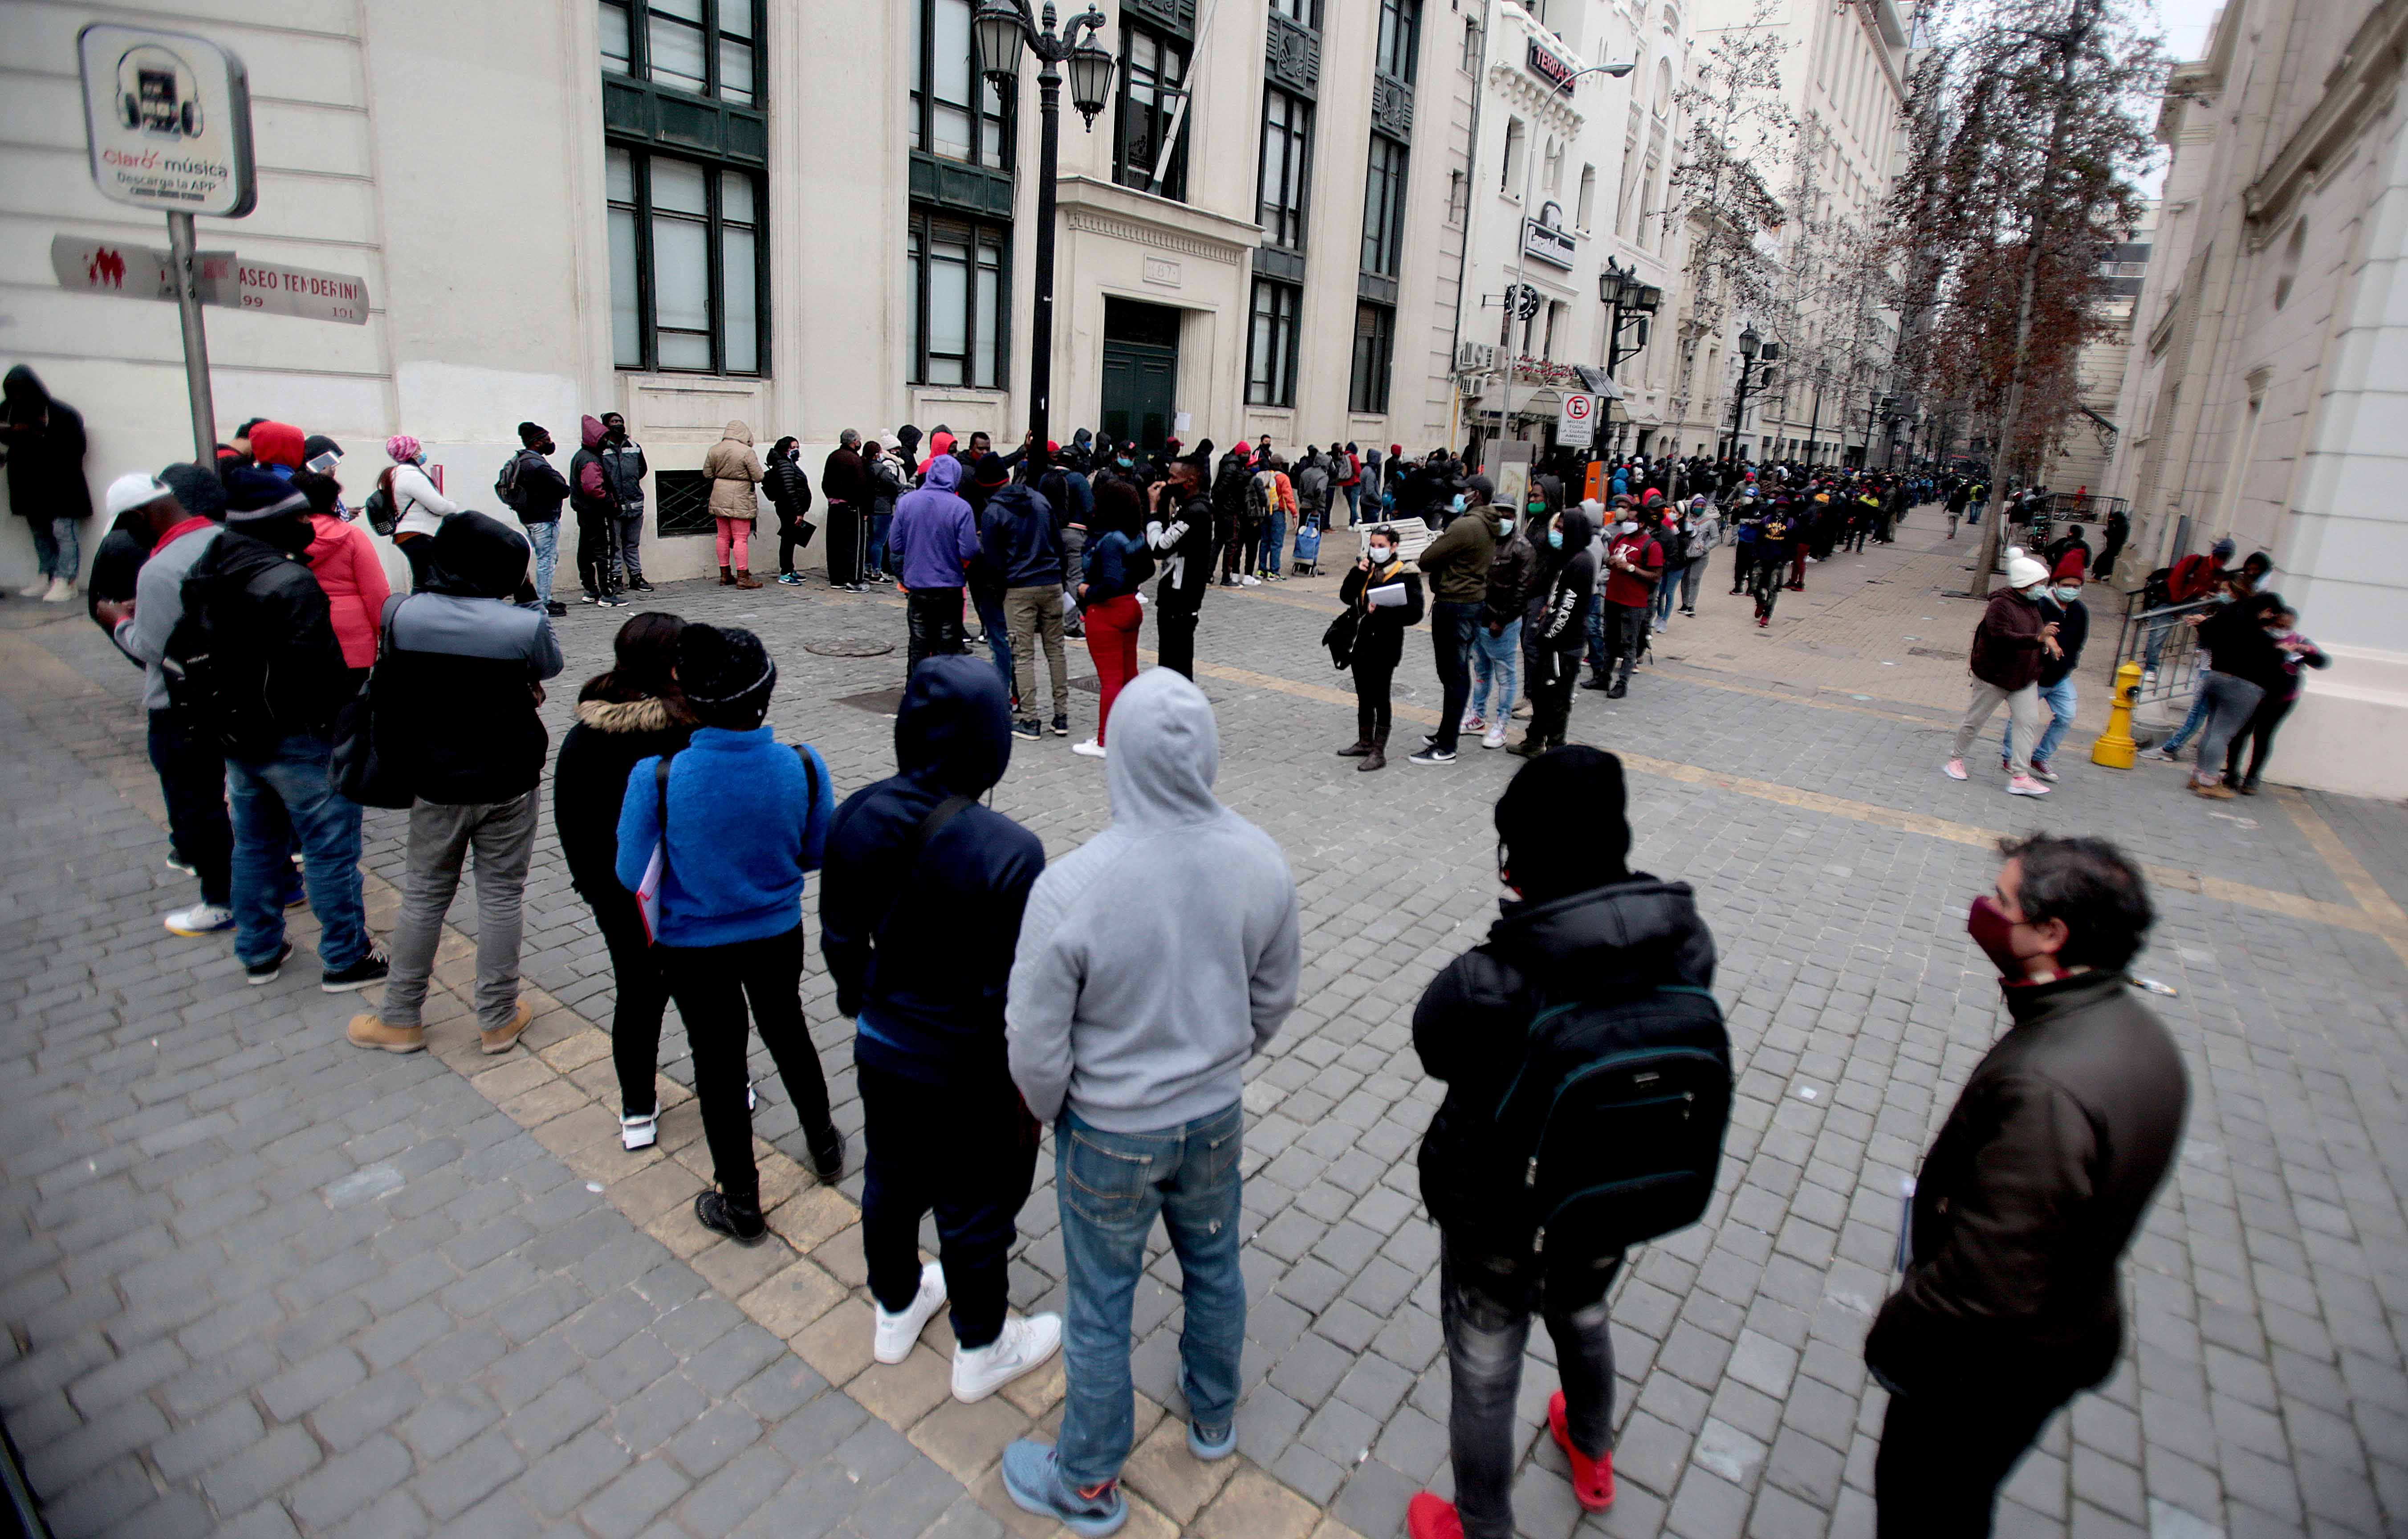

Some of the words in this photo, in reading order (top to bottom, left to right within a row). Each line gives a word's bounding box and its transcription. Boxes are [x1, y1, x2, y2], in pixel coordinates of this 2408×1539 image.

[163, 156, 228, 178] música
[117, 170, 173, 190] Descarga
[191, 179, 216, 191] APP
[239, 266, 277, 289] ASEO
[282, 273, 358, 300] TENDERINI
[240, 294, 264, 308] 99
[332, 306, 354, 319] 101
[1562, 588, 1578, 610] AIR
